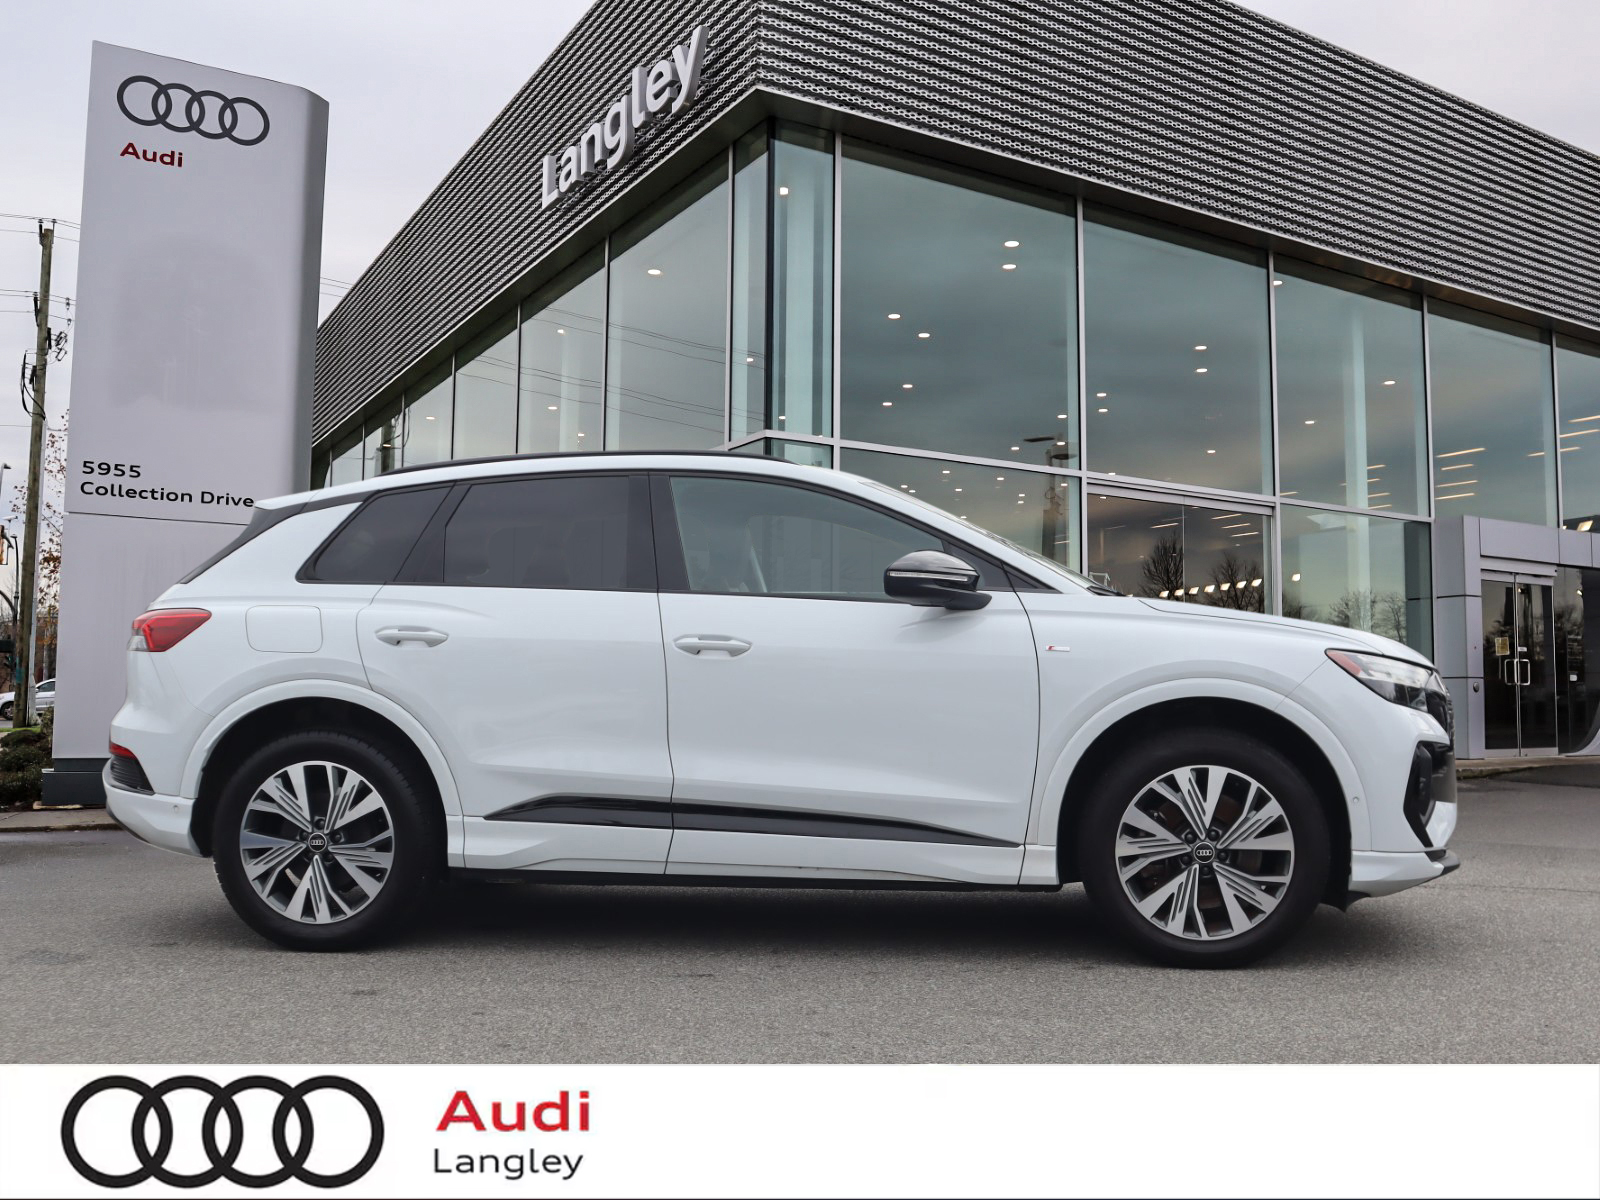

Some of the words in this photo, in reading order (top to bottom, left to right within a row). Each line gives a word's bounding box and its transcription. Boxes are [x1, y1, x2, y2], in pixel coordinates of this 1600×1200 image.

[541, 24, 710, 209] Langley
[119, 142, 183, 168] Audi
[81, 460, 142, 478] 5955
[79, 481, 193, 503] Collection
[200, 491, 254, 507] Drive
